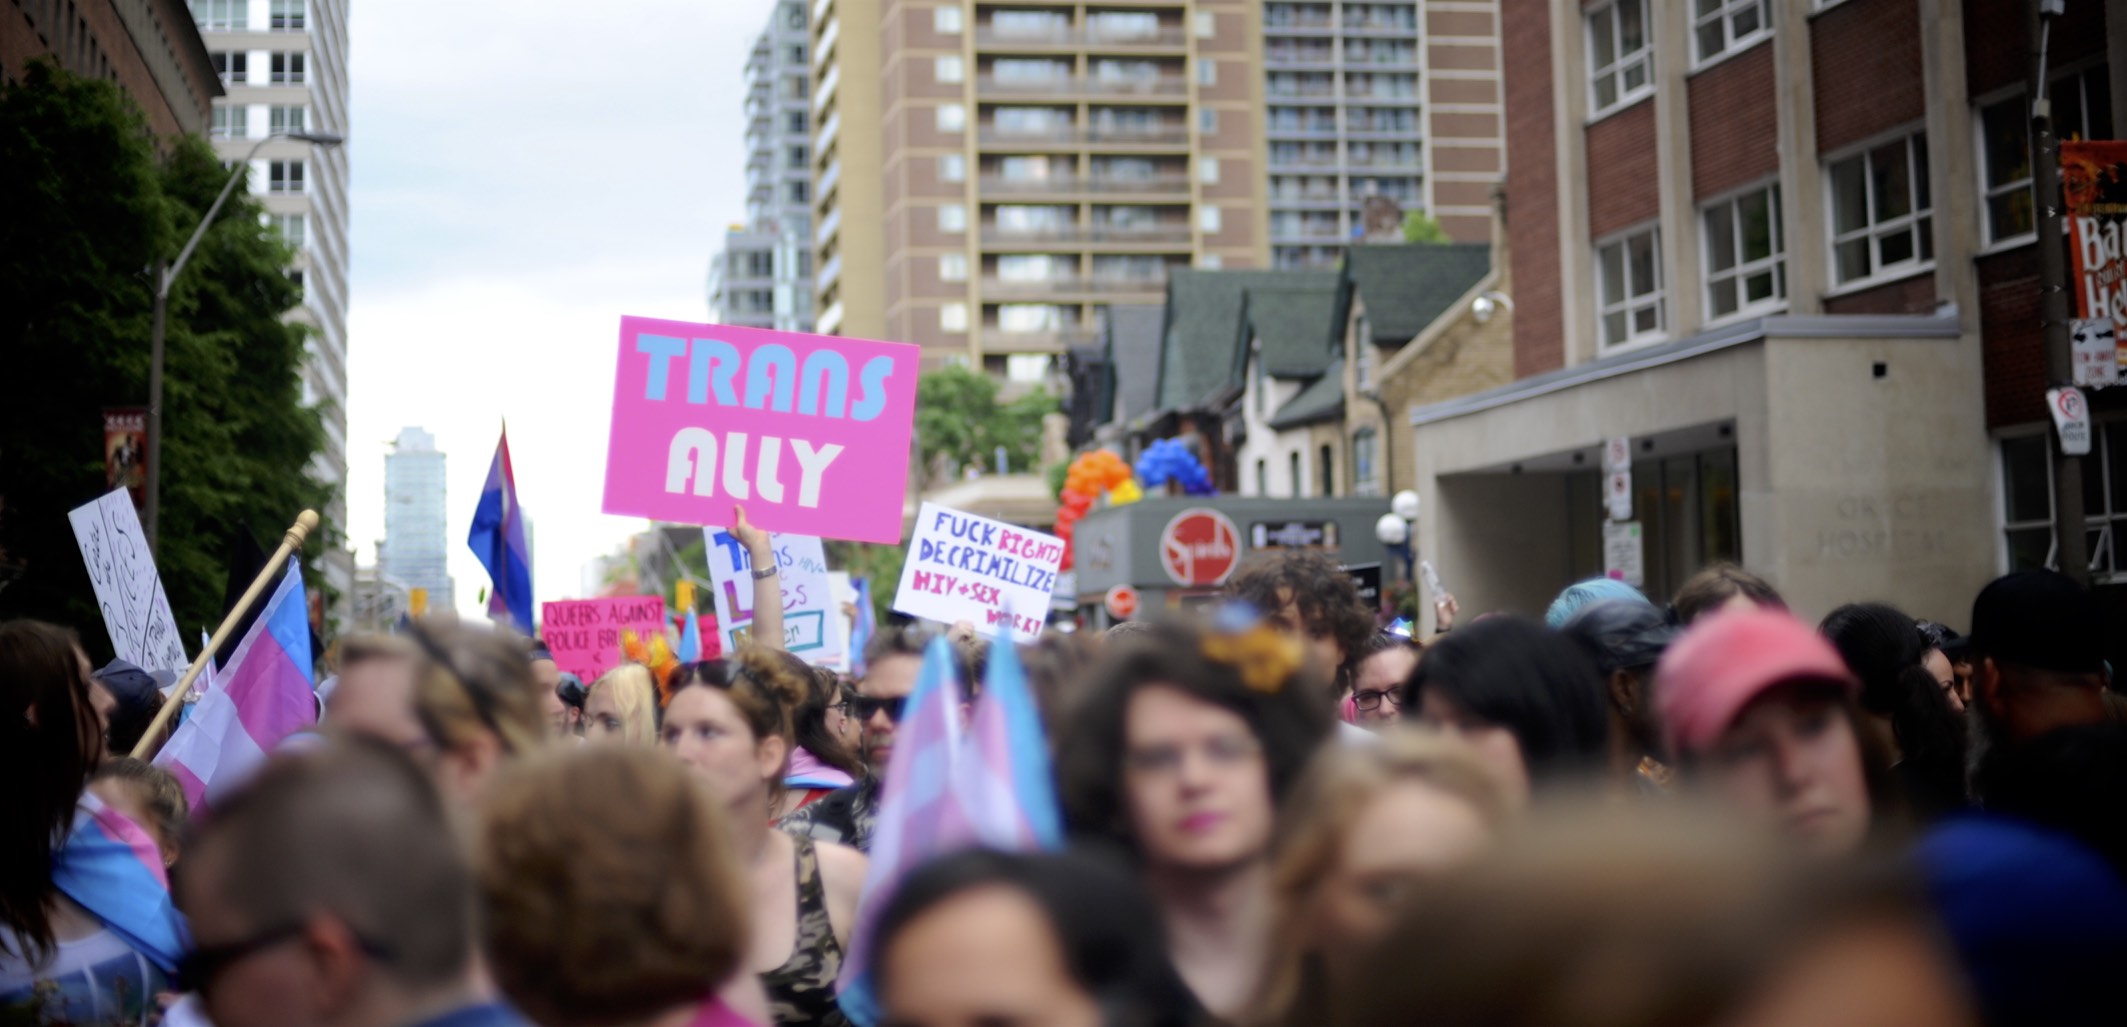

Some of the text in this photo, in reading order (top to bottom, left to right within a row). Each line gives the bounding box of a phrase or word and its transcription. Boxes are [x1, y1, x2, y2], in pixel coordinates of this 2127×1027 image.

[637, 333, 895, 422] TRANS
[665, 427, 845, 508] ALLY
[934, 511, 997, 546] FUCK
[998, 529, 1063, 564] RIGHTS
[912, 569, 958, 596] HIV
[543, 601, 663, 627] QUEERS AGAINST
[546, 630, 589, 651] POLICE
